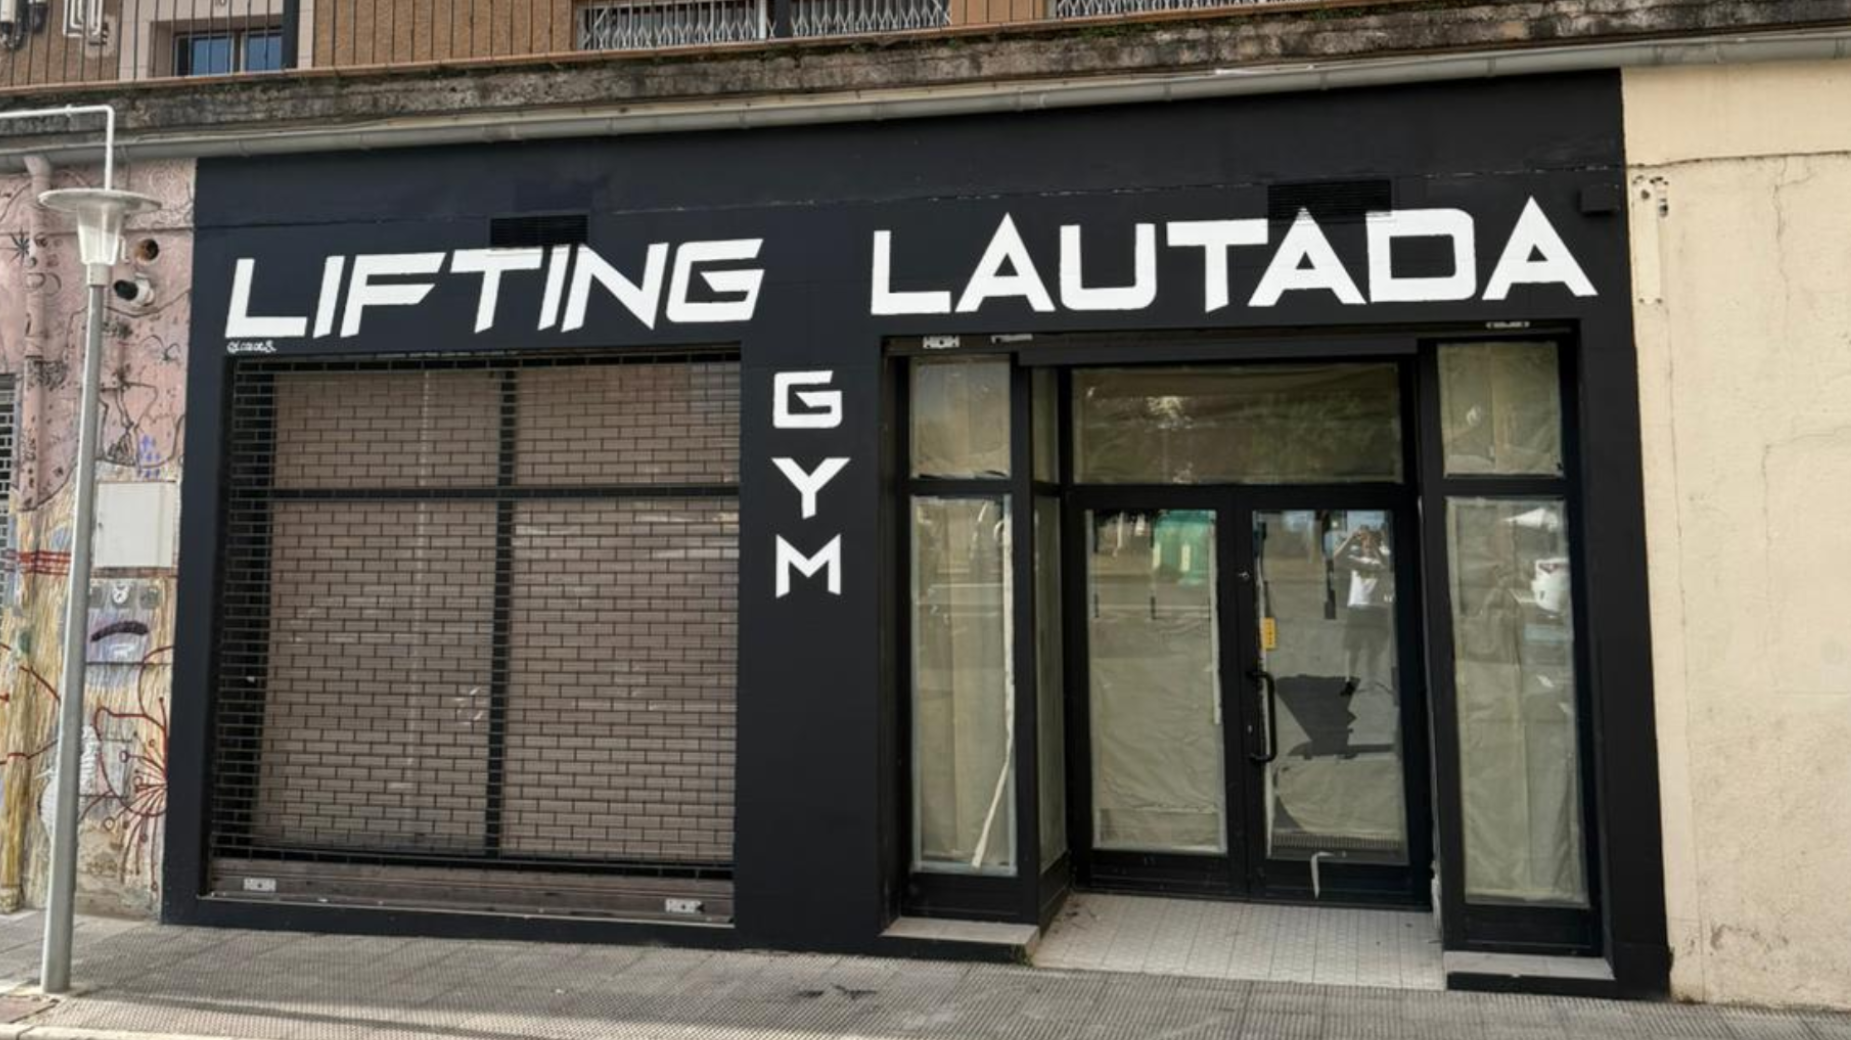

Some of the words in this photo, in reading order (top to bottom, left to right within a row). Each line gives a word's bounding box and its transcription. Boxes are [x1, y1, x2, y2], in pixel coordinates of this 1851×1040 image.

[225, 239, 764, 338] LIFTING
[871, 197, 1597, 315] LAUTADA
[772, 371, 849, 597] GYM
